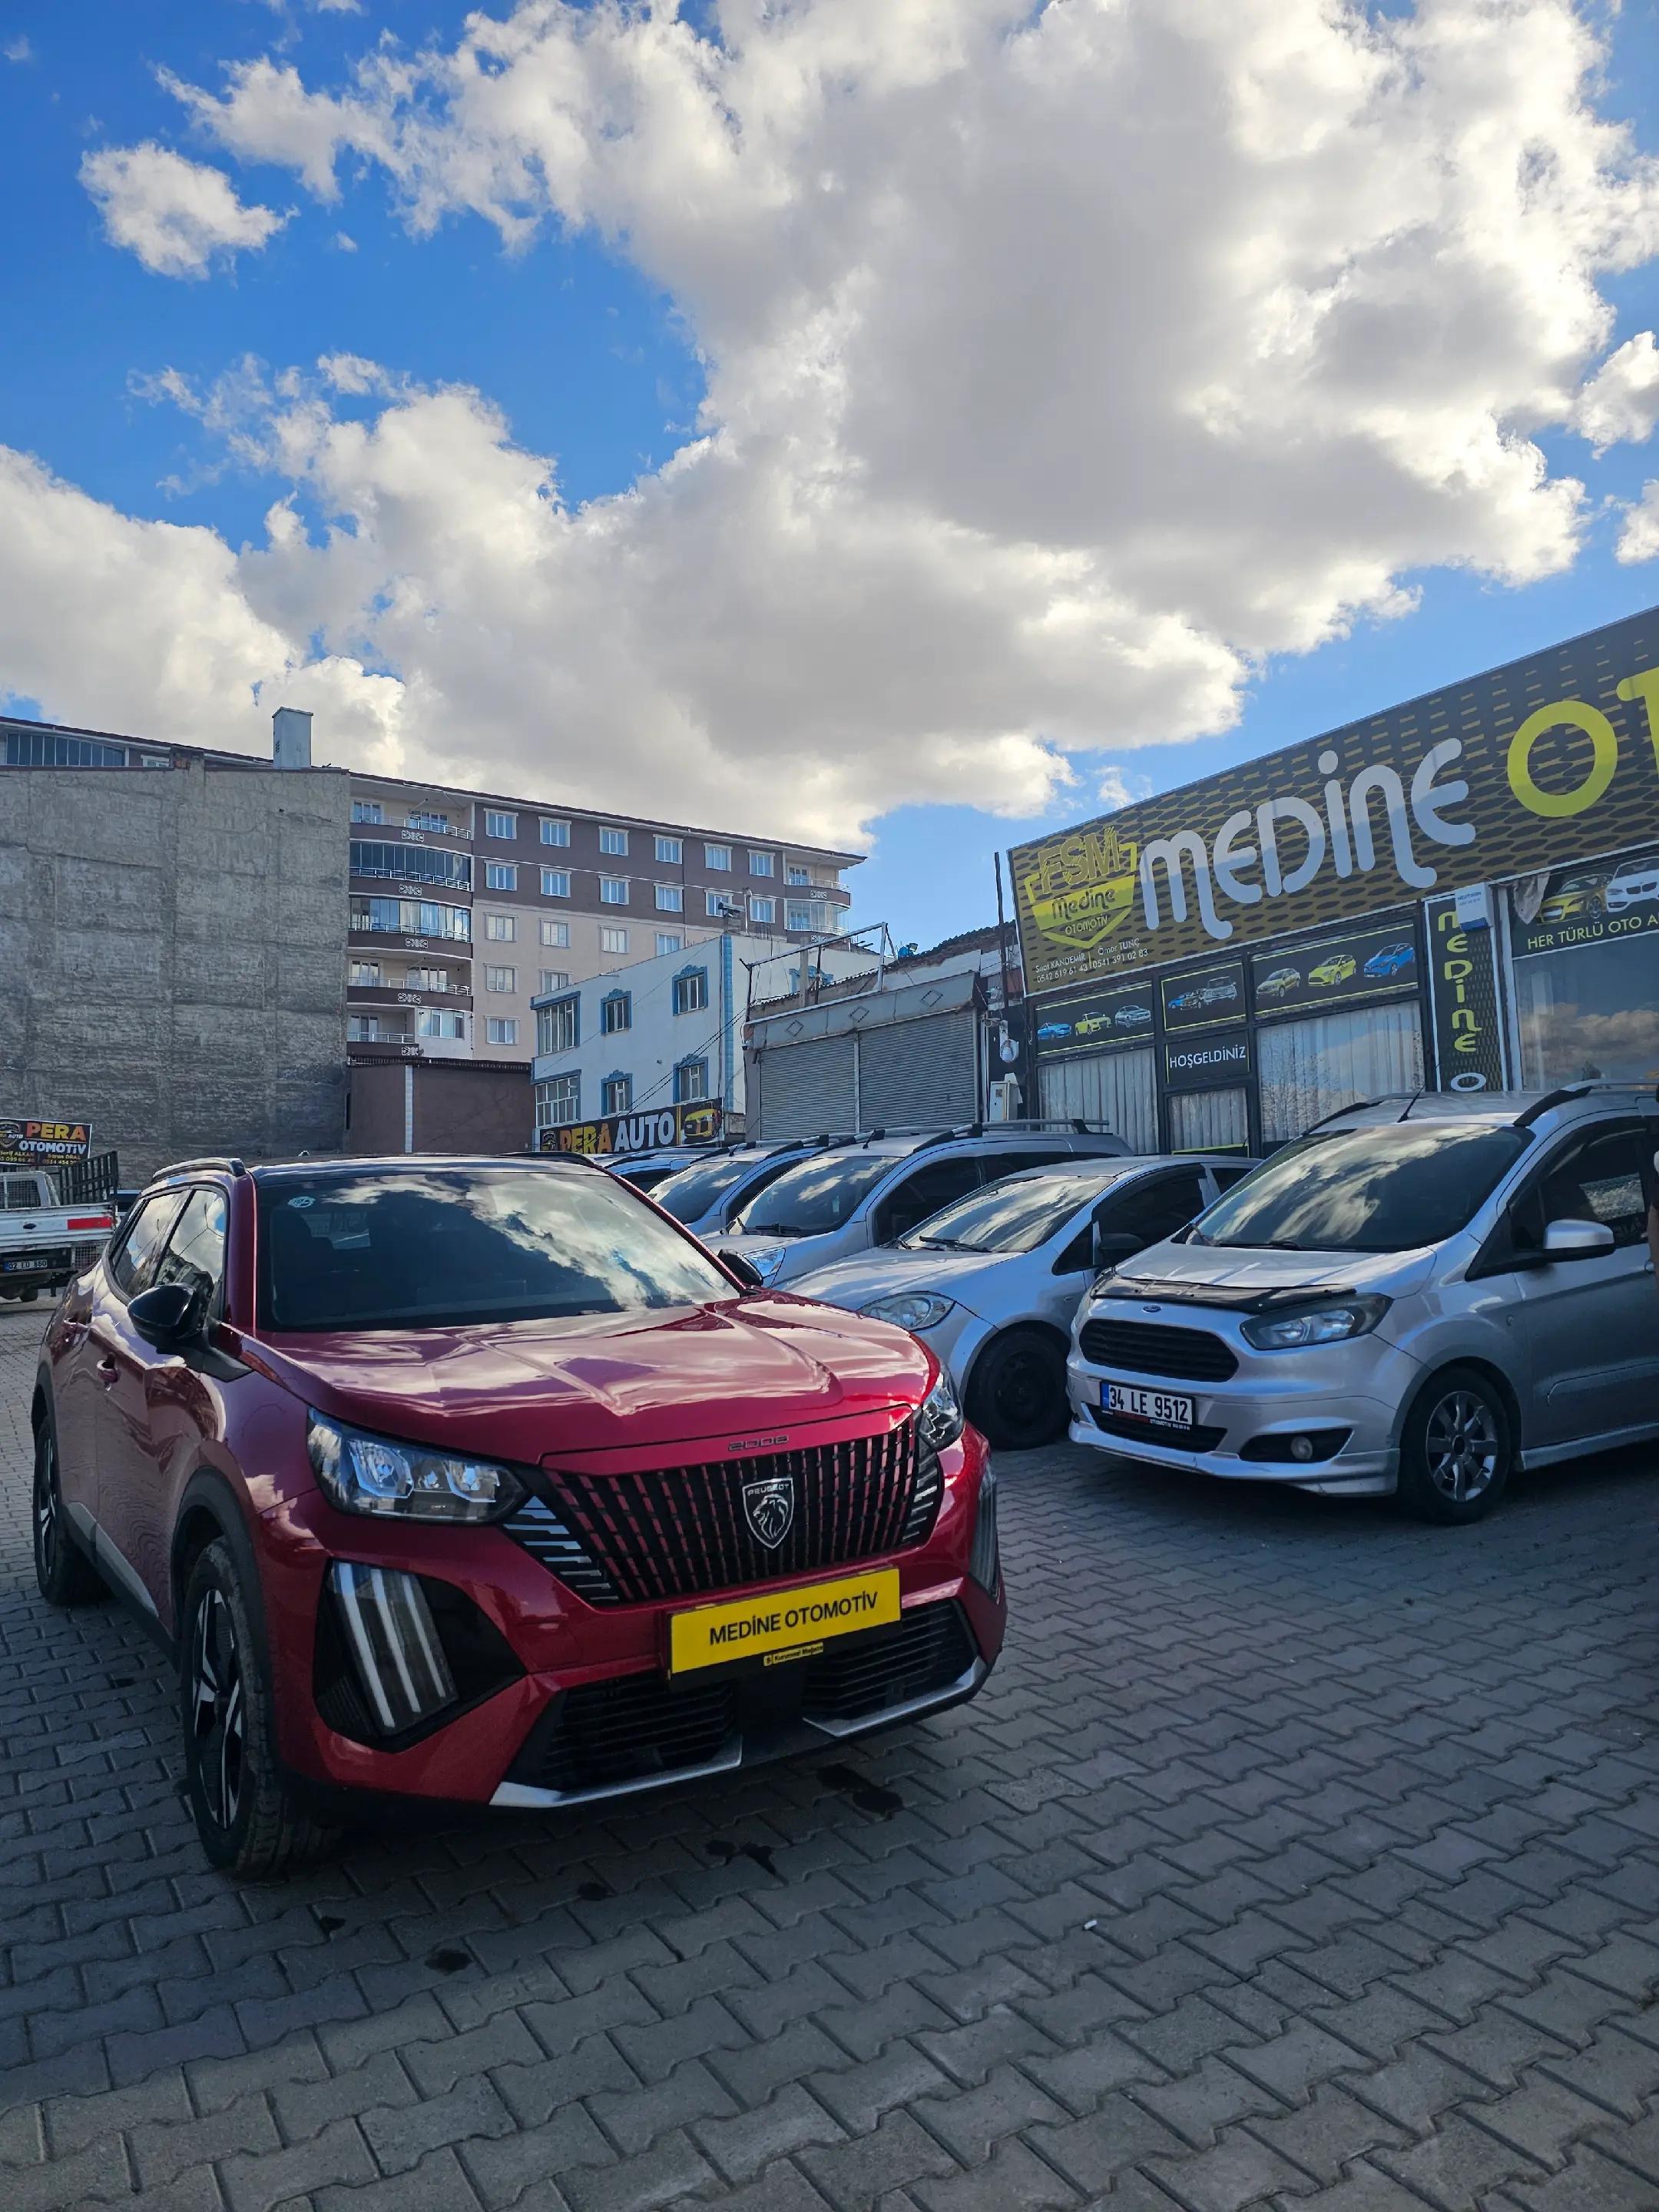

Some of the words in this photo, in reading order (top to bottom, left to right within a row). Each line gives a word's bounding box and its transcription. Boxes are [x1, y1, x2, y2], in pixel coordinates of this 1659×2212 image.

[1038, 826, 1121, 895] FSM
[1528, 934, 1555, 950] HER
[1558, 921, 1604, 943] TÜRLÜ
[1608, 916, 1642, 933] OTO
[1647, 912, 1659, 926] A
[1119, 938, 1141, 951] TUNÇ
[1128, 951, 1137, 961] 02
[1170, 1045, 1247, 1068] HOŞGELDİNİZ
[26, 1122, 87, 1141] PERA
[560, 1123, 612, 1154] PERA
[614, 1112, 675, 1151] AUTO
[1110, 1387, 1124, 1409] 34
[1131, 1391, 1147, 1414] LE
[1154, 1396, 1189, 1422] 9512
[729, 1435, 790, 1451] 2008
[747, 1483, 790, 1496] PEUGEOT
[710, 1613, 782, 1645] MEDİNE
[784, 1590, 878, 1628] OTOMOTİV
